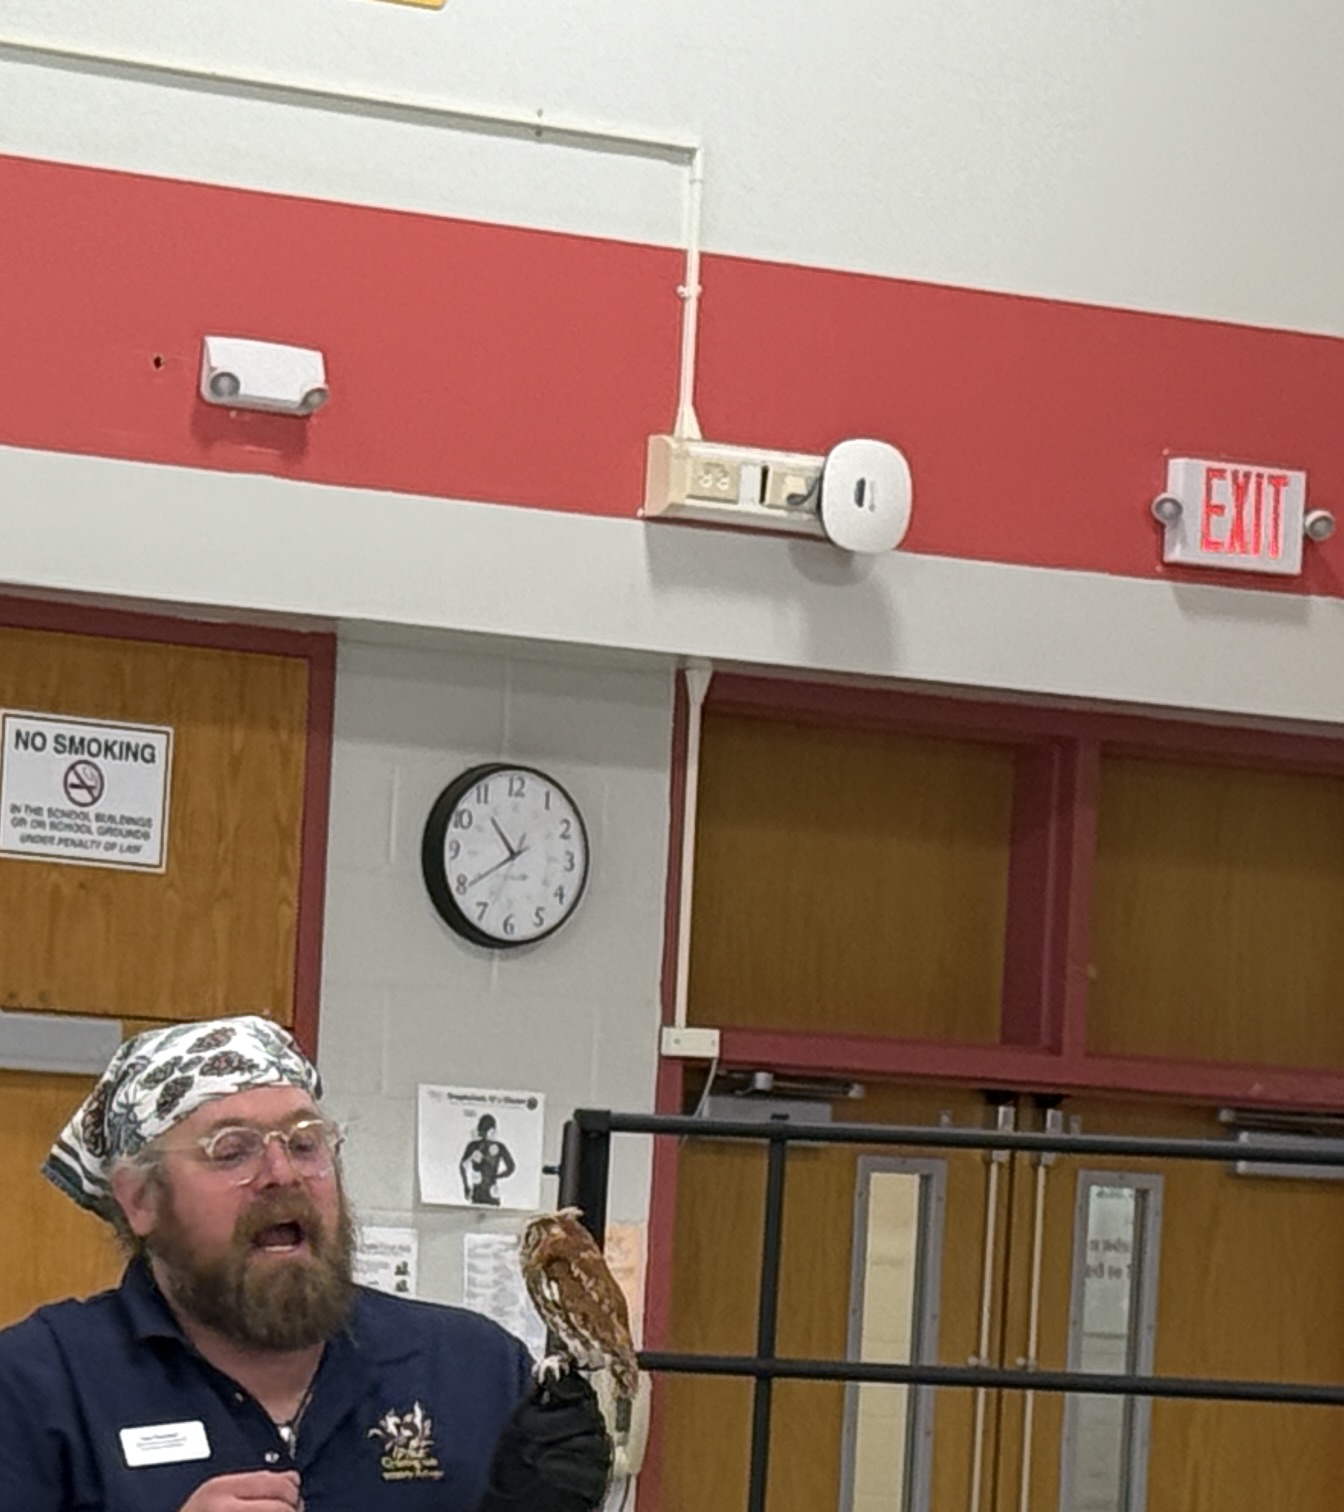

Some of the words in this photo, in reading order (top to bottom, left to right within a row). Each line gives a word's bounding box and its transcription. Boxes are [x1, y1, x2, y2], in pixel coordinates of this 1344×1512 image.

[1201, 467, 1289, 559] EXIT
[14, 729, 47, 752] NO
[53, 734, 157, 764] SMOKING
[476, 783, 489, 805] 11
[507, 776, 526, 798] 12
[544, 790, 550, 811] 1
[453, 808, 473, 830] 10
[559, 818, 572, 840] 2
[448, 840, 461, 860] 9
[563, 850, 575, 873] 3
[456, 873, 468, 895] 8
[554, 885, 565, 906] 4
[475, 901, 489, 922] 7
[533, 906, 545, 928] 5
[503, 914, 515, 935] 6
